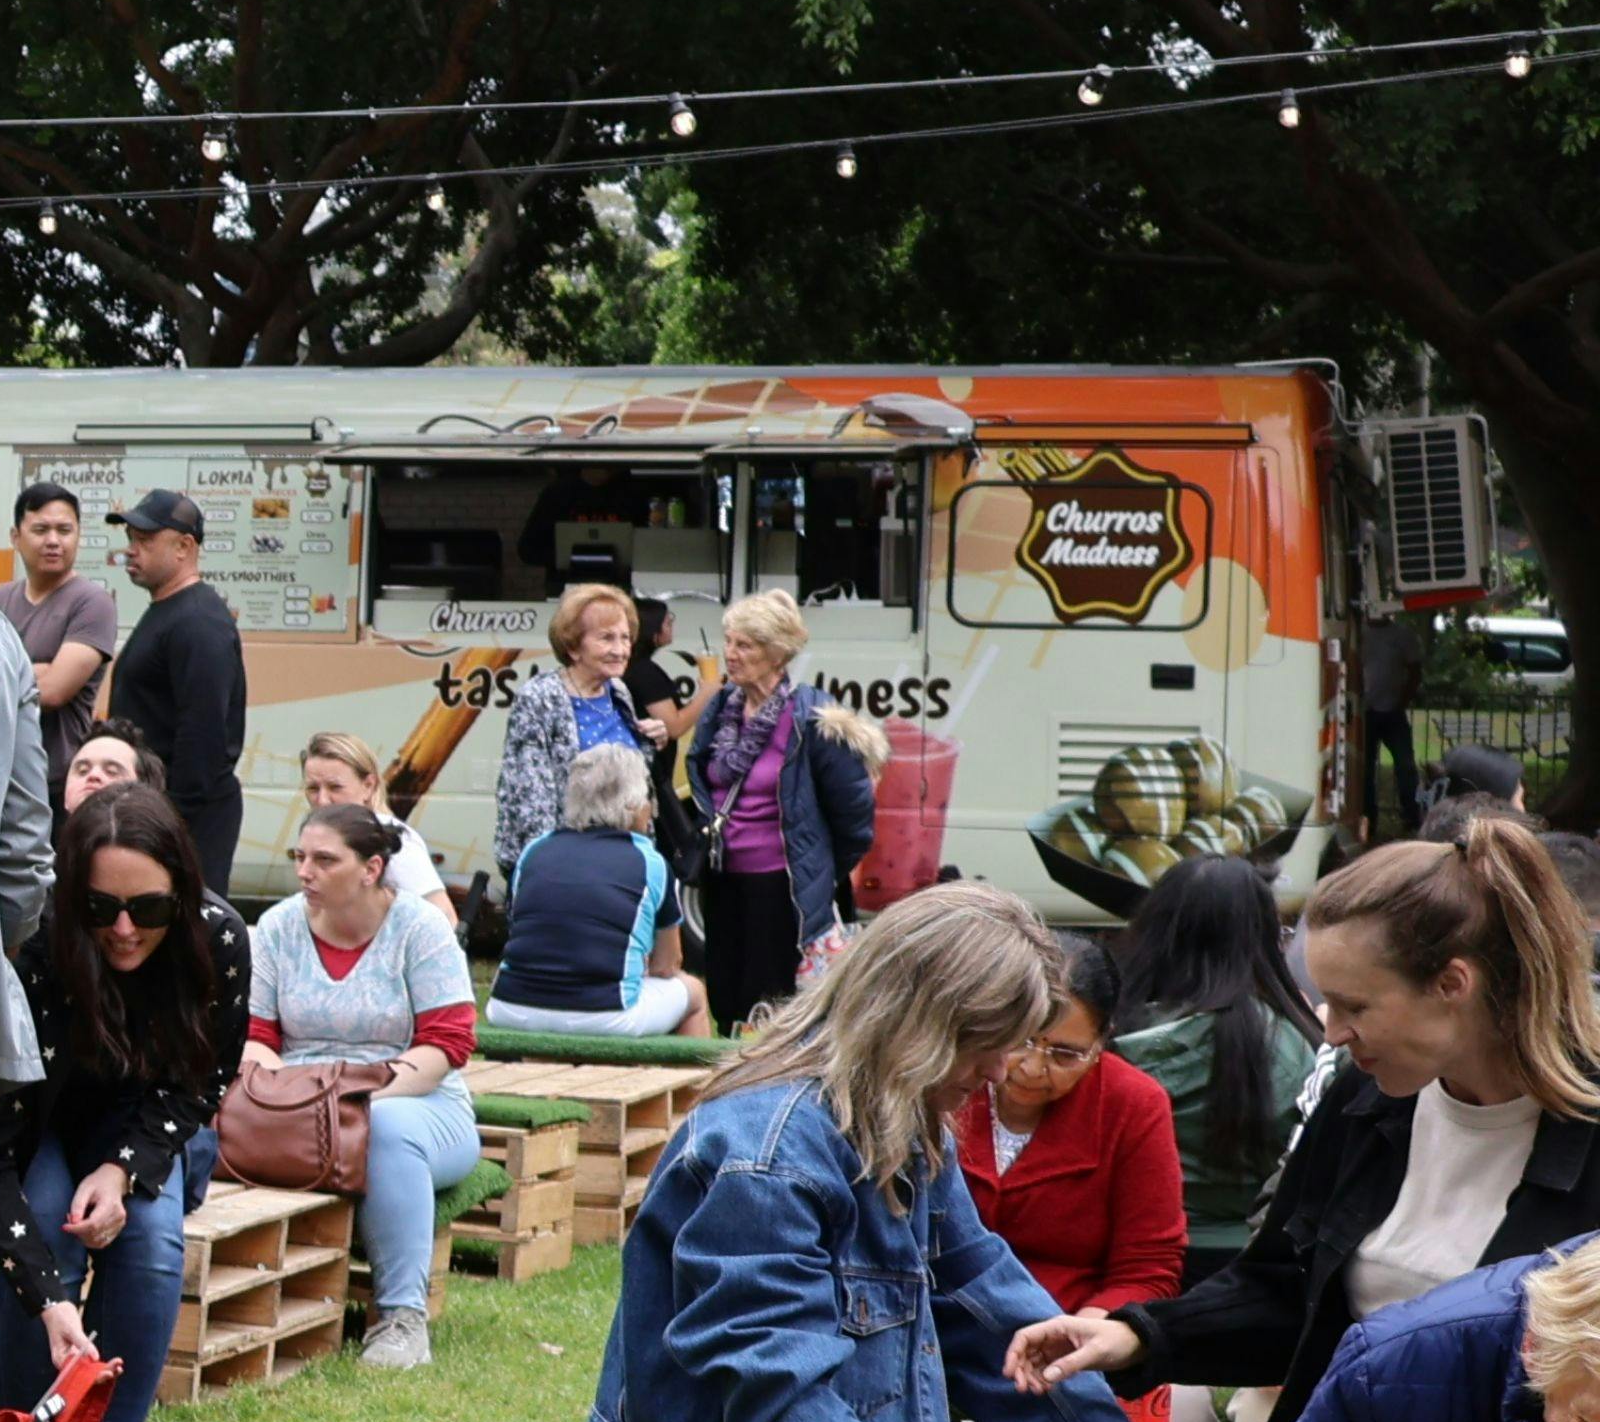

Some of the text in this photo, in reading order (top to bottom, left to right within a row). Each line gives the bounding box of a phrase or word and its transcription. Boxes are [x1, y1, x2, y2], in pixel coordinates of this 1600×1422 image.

[51, 470, 125, 486] CHURROS
[197, 470, 255, 486] LOKMA
[1047, 499, 1164, 533] Churros
[1040, 535, 1160, 566] Madness
[200, 571, 297, 583] PPES/SMOOTHIES
[430, 602, 537, 632] Churros
[433, 661, 540, 709] tas
